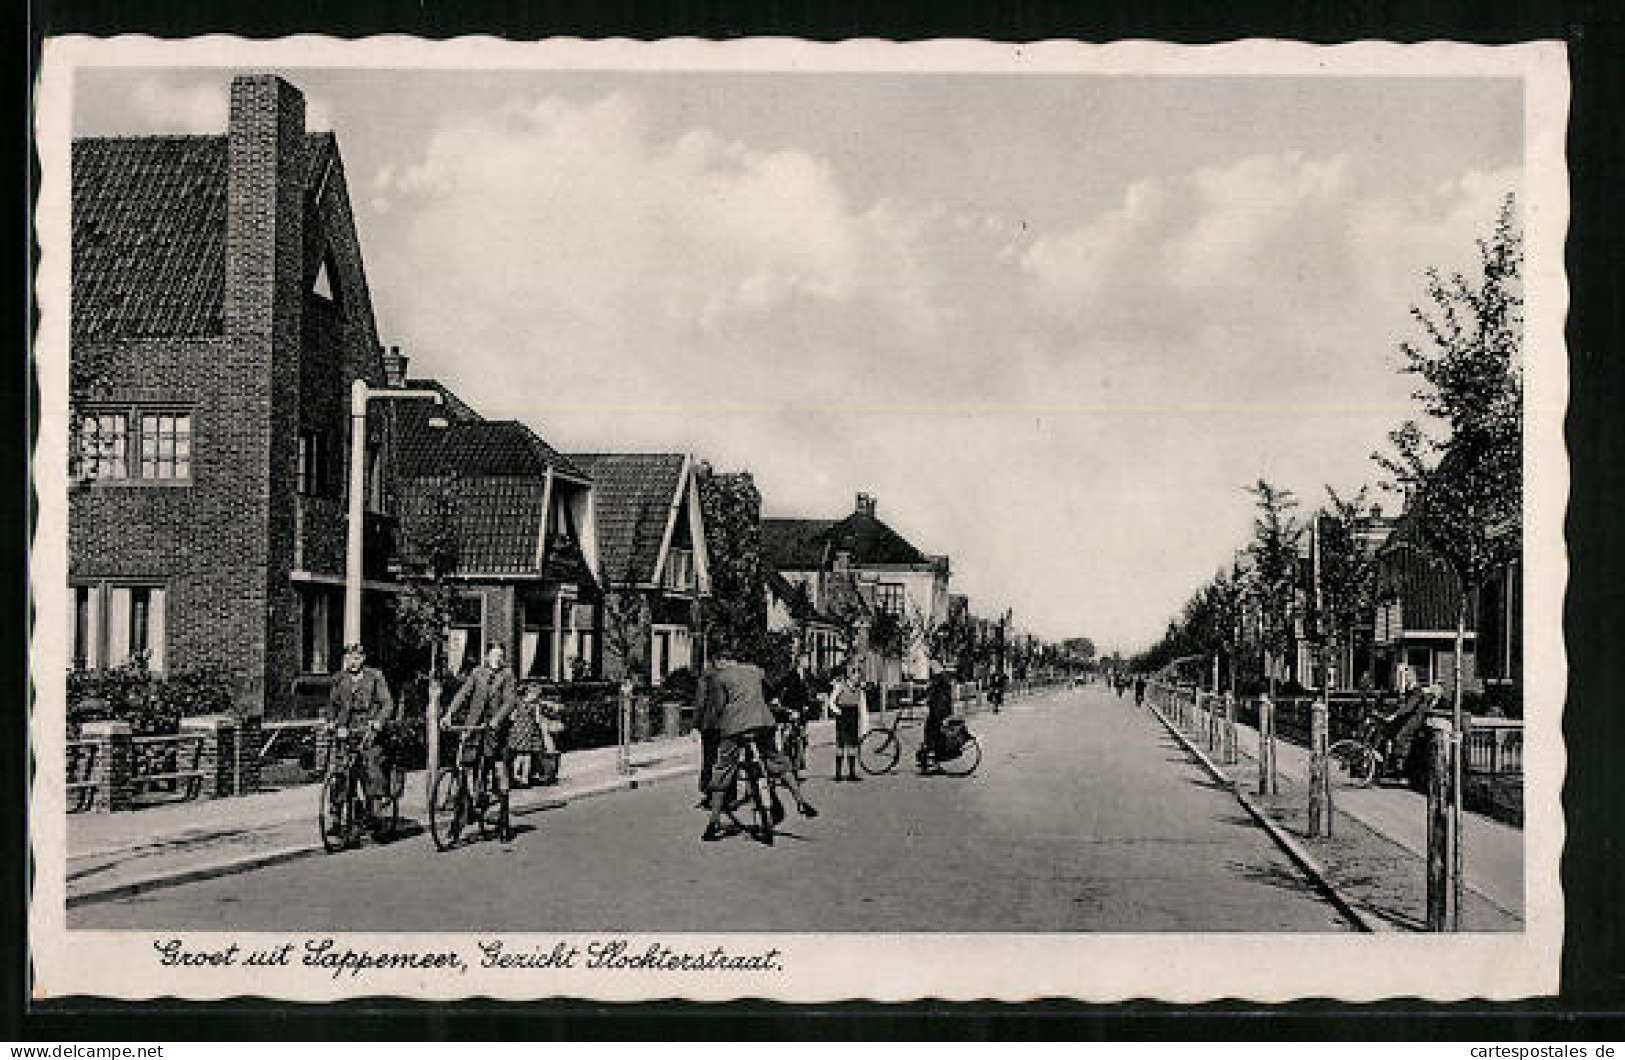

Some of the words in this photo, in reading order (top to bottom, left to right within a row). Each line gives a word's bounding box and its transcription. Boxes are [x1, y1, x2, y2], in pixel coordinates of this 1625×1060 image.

[153, 939, 239, 966] Groet
[242, 942, 295, 966] uit
[301, 939, 468, 979] Sappemeer,
[478, 940, 580, 968] Gezicht
[586, 940, 782, 970] Slochterstraat.
